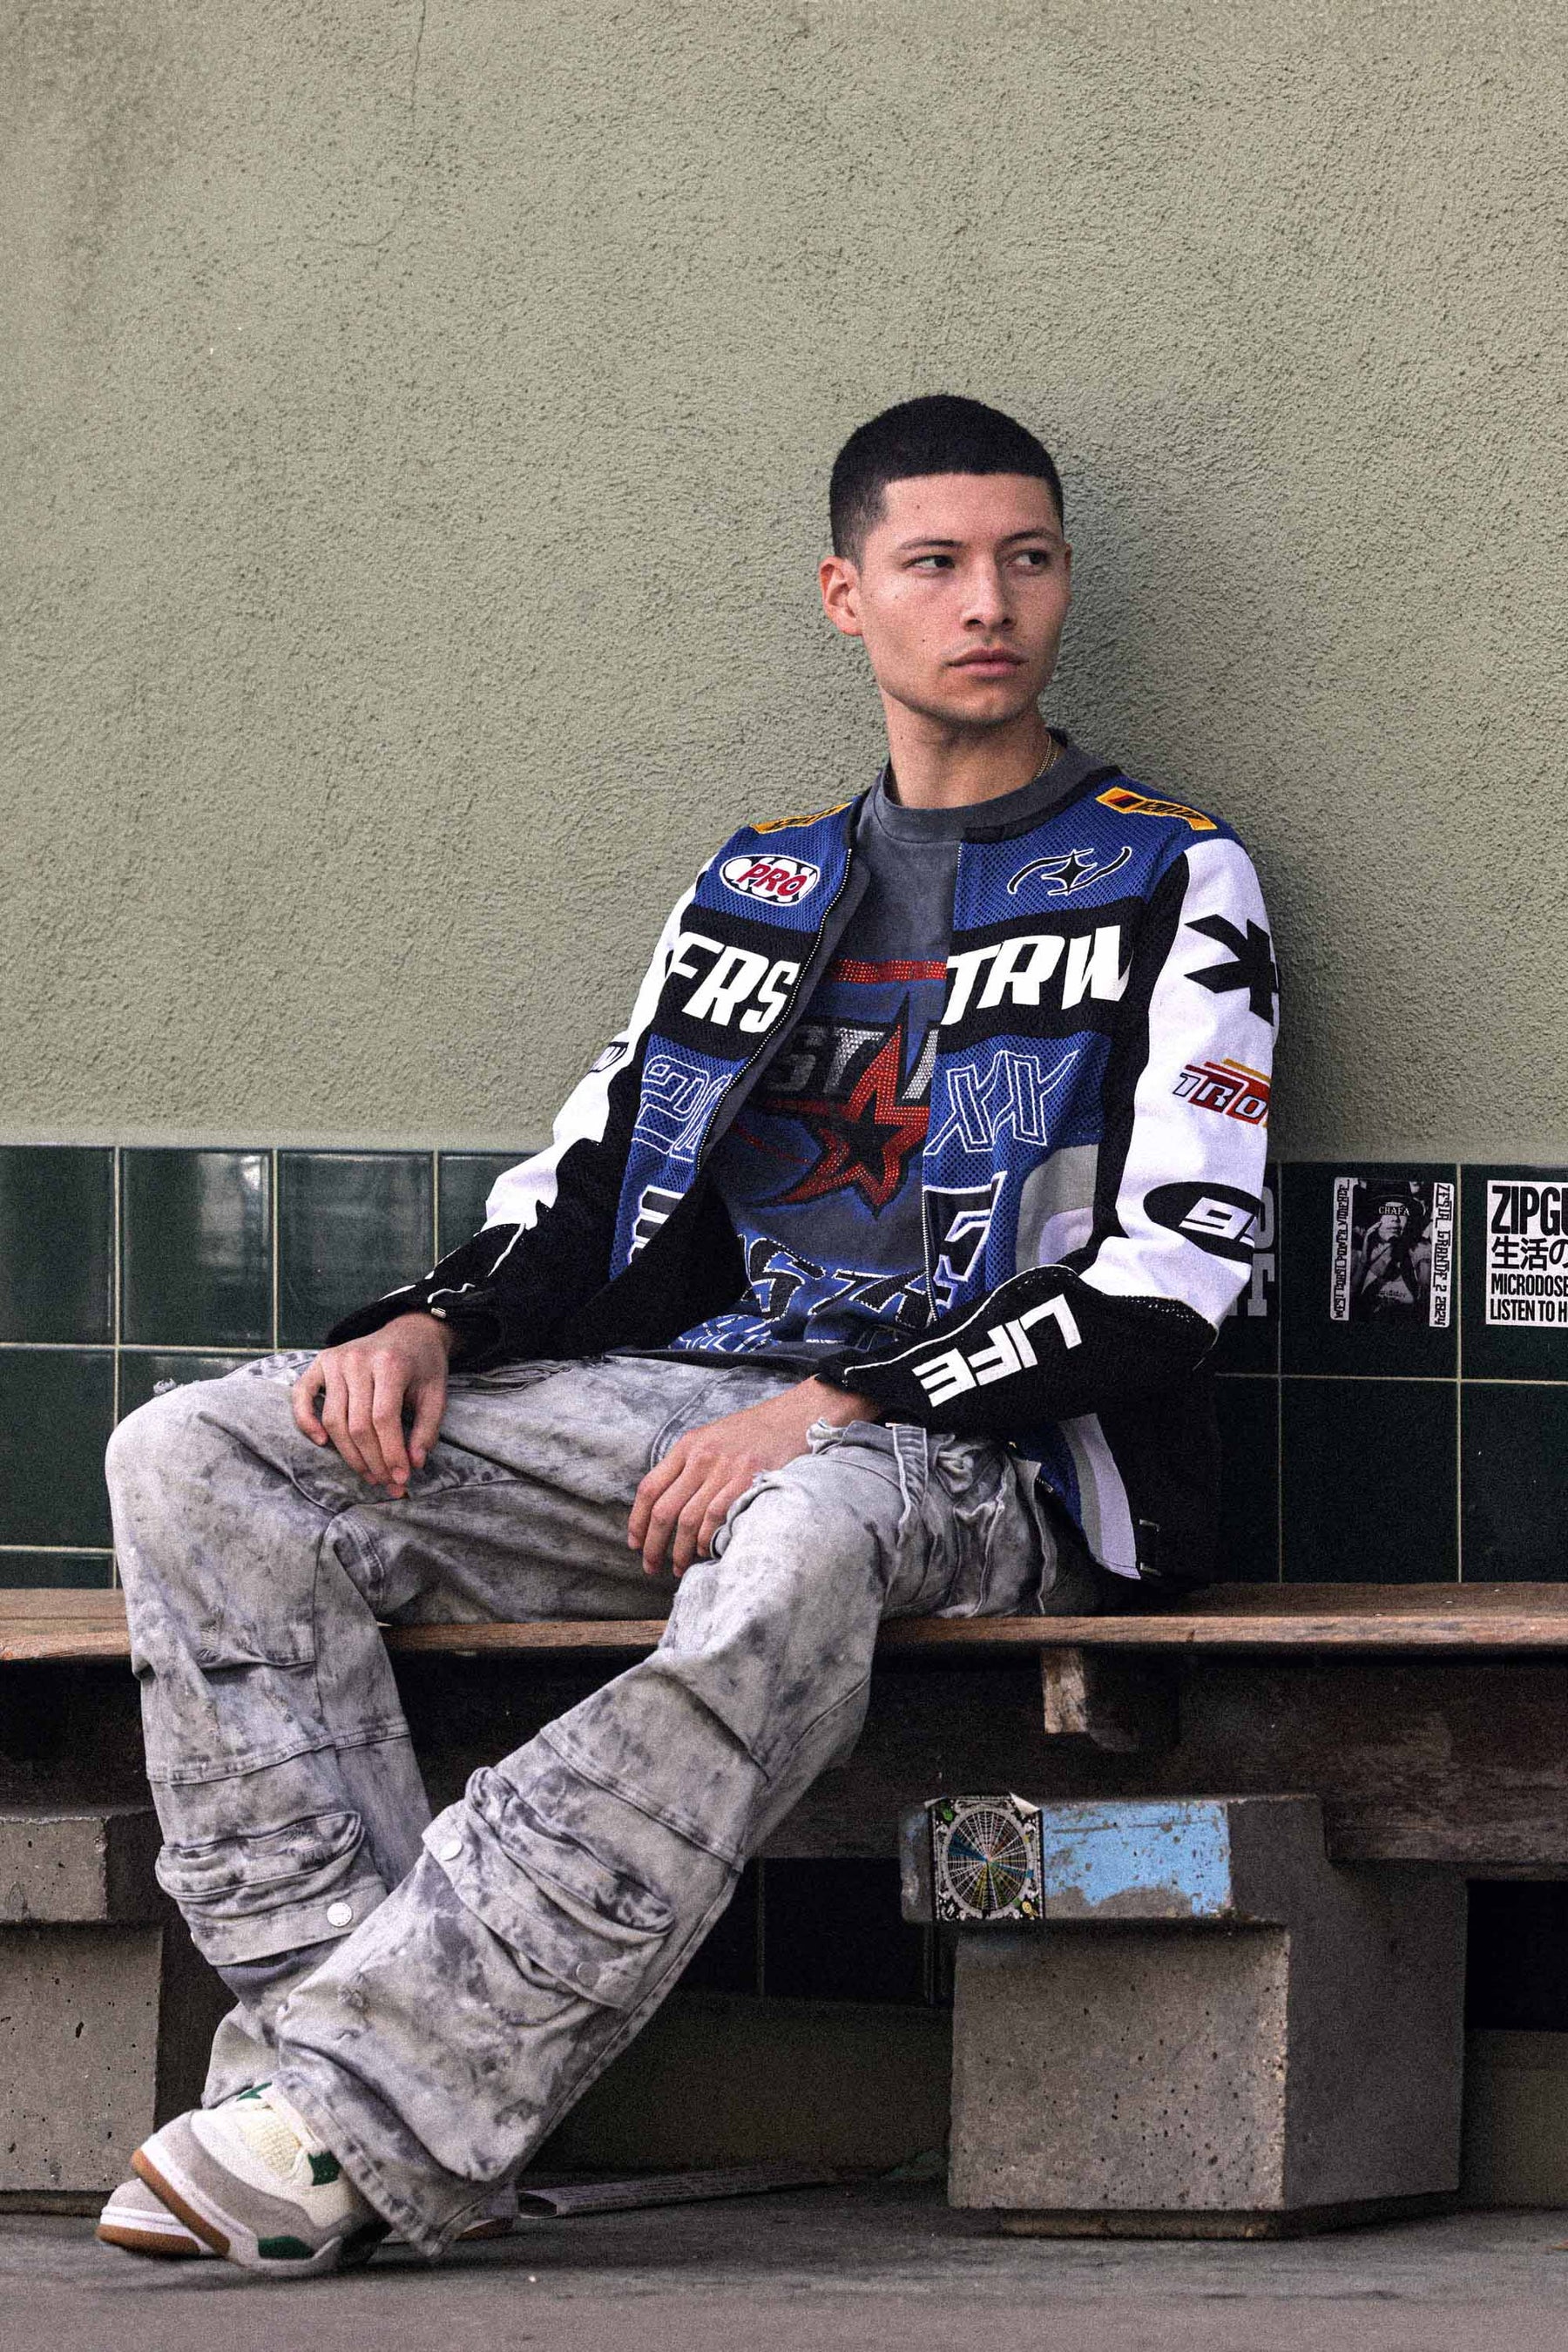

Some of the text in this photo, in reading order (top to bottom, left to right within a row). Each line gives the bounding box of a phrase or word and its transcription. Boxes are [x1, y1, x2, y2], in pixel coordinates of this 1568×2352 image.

[736, 863, 807, 896] PRO
[1433, 1230, 1450, 1288] GRANDE
[1491, 1235, 1568, 1271] 生活の
[1435, 1296, 1446, 1325] 2024
[1490, 1298, 1535, 1321] LISTEN
[1538, 1300, 1555, 1322] TO
[911, 1294, 1082, 1408] LIFE
